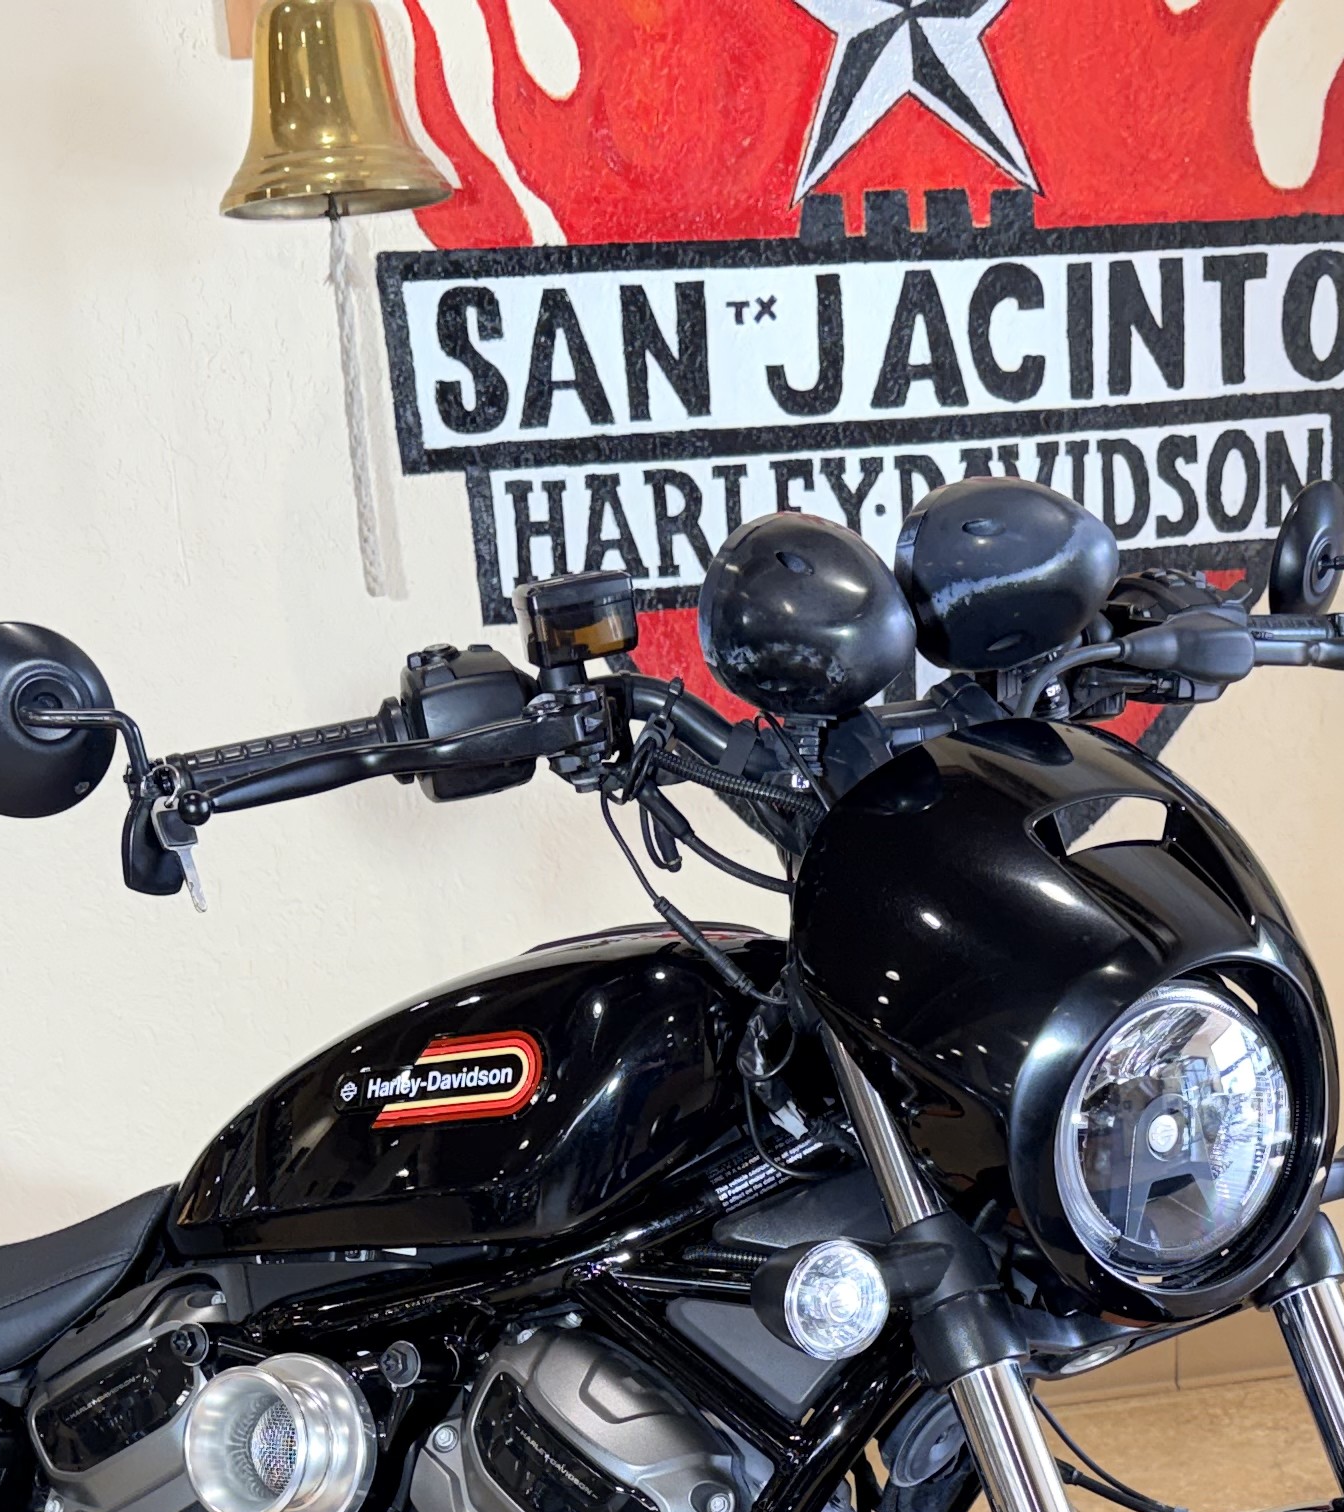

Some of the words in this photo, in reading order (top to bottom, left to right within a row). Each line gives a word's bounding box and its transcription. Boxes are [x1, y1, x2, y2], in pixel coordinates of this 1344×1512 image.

[433, 279, 710, 437] SAN
[725, 294, 777, 325] TX
[366, 1066, 514, 1100] Harley-Davidson
